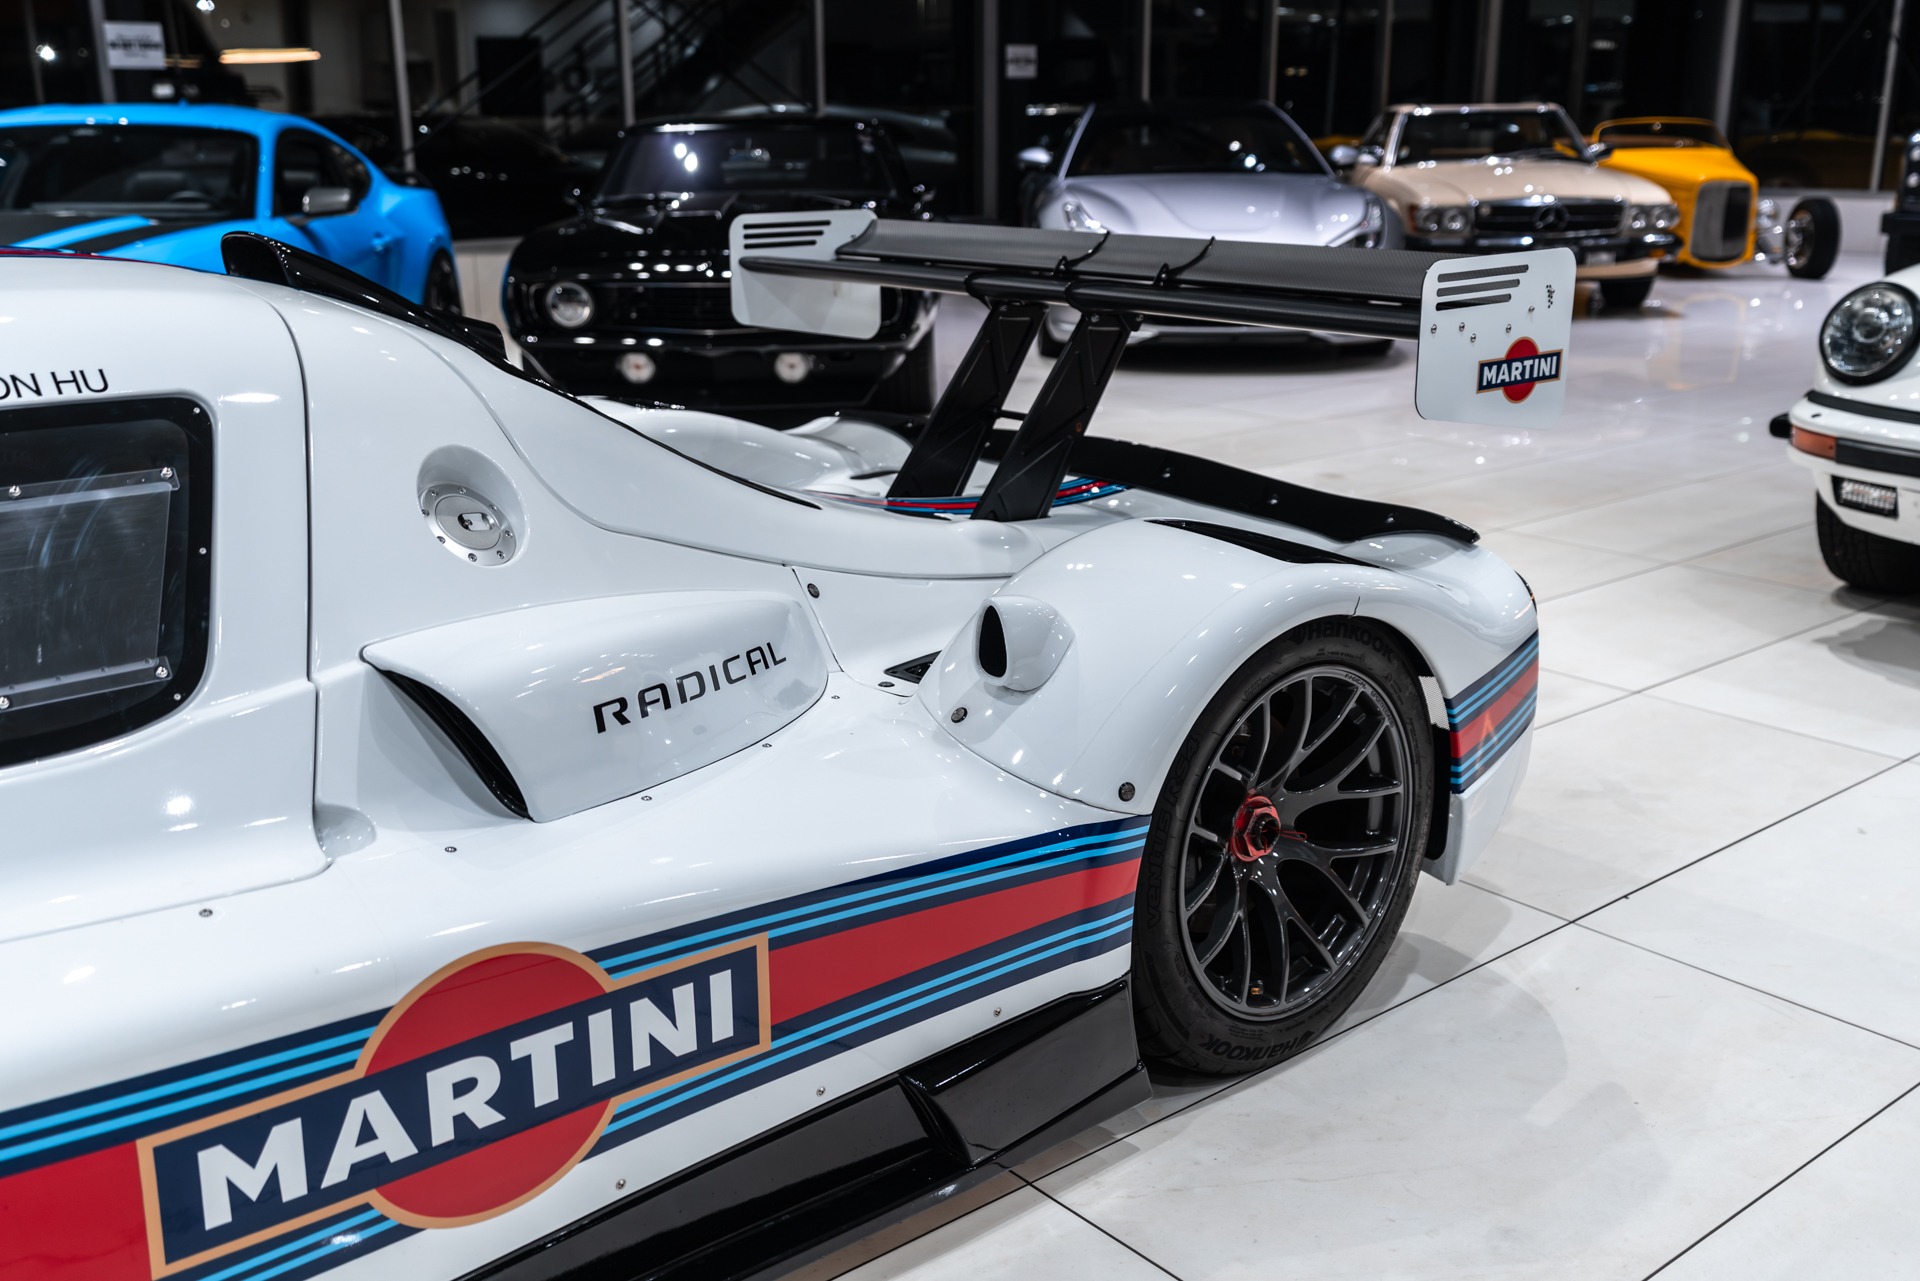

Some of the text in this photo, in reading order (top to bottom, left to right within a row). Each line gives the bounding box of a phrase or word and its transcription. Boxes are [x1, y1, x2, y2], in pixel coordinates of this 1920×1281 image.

[50, 369, 109, 395] HU
[1483, 355, 1558, 386] MARTINI
[593, 641, 787, 734] RADICAL
[196, 969, 737, 1231] MARTINI
